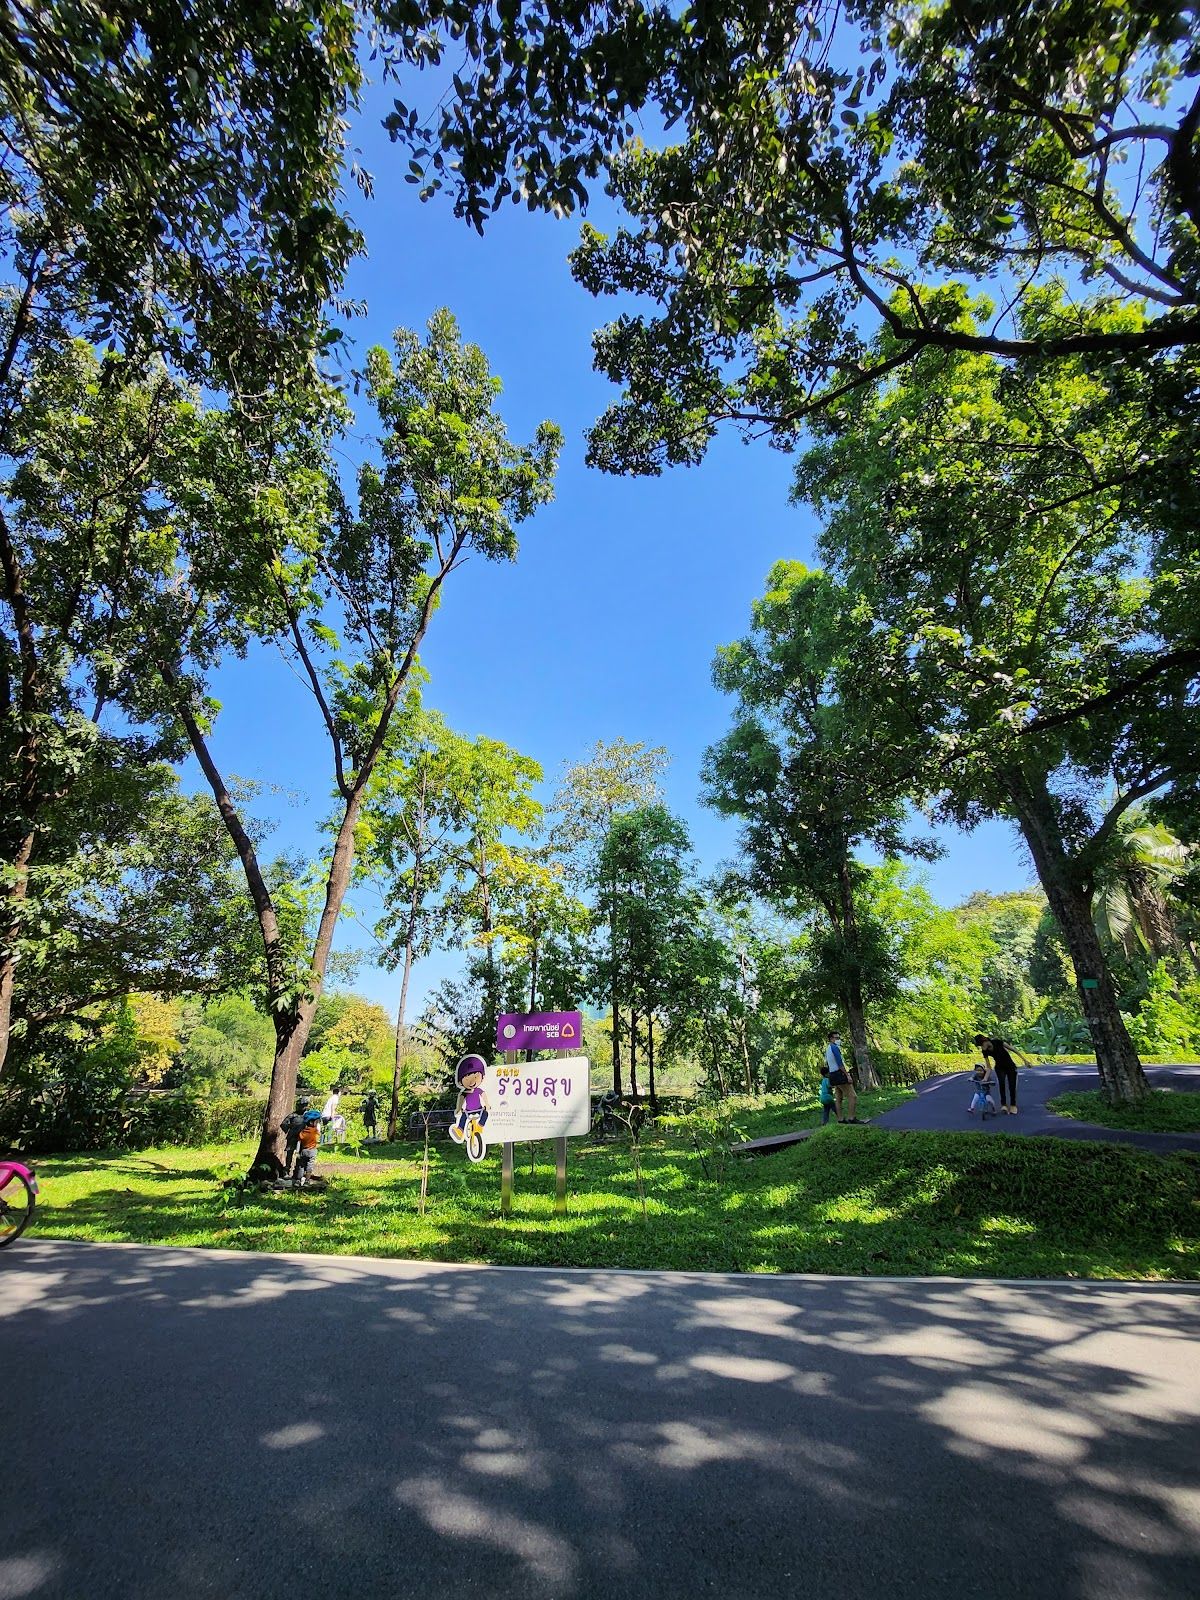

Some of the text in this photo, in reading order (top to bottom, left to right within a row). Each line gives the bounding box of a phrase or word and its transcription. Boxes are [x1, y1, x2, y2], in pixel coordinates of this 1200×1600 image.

[523, 1023, 560, 1032] ไทยพาณิชย์
[498, 1077, 572, 1106] รวมสุข
